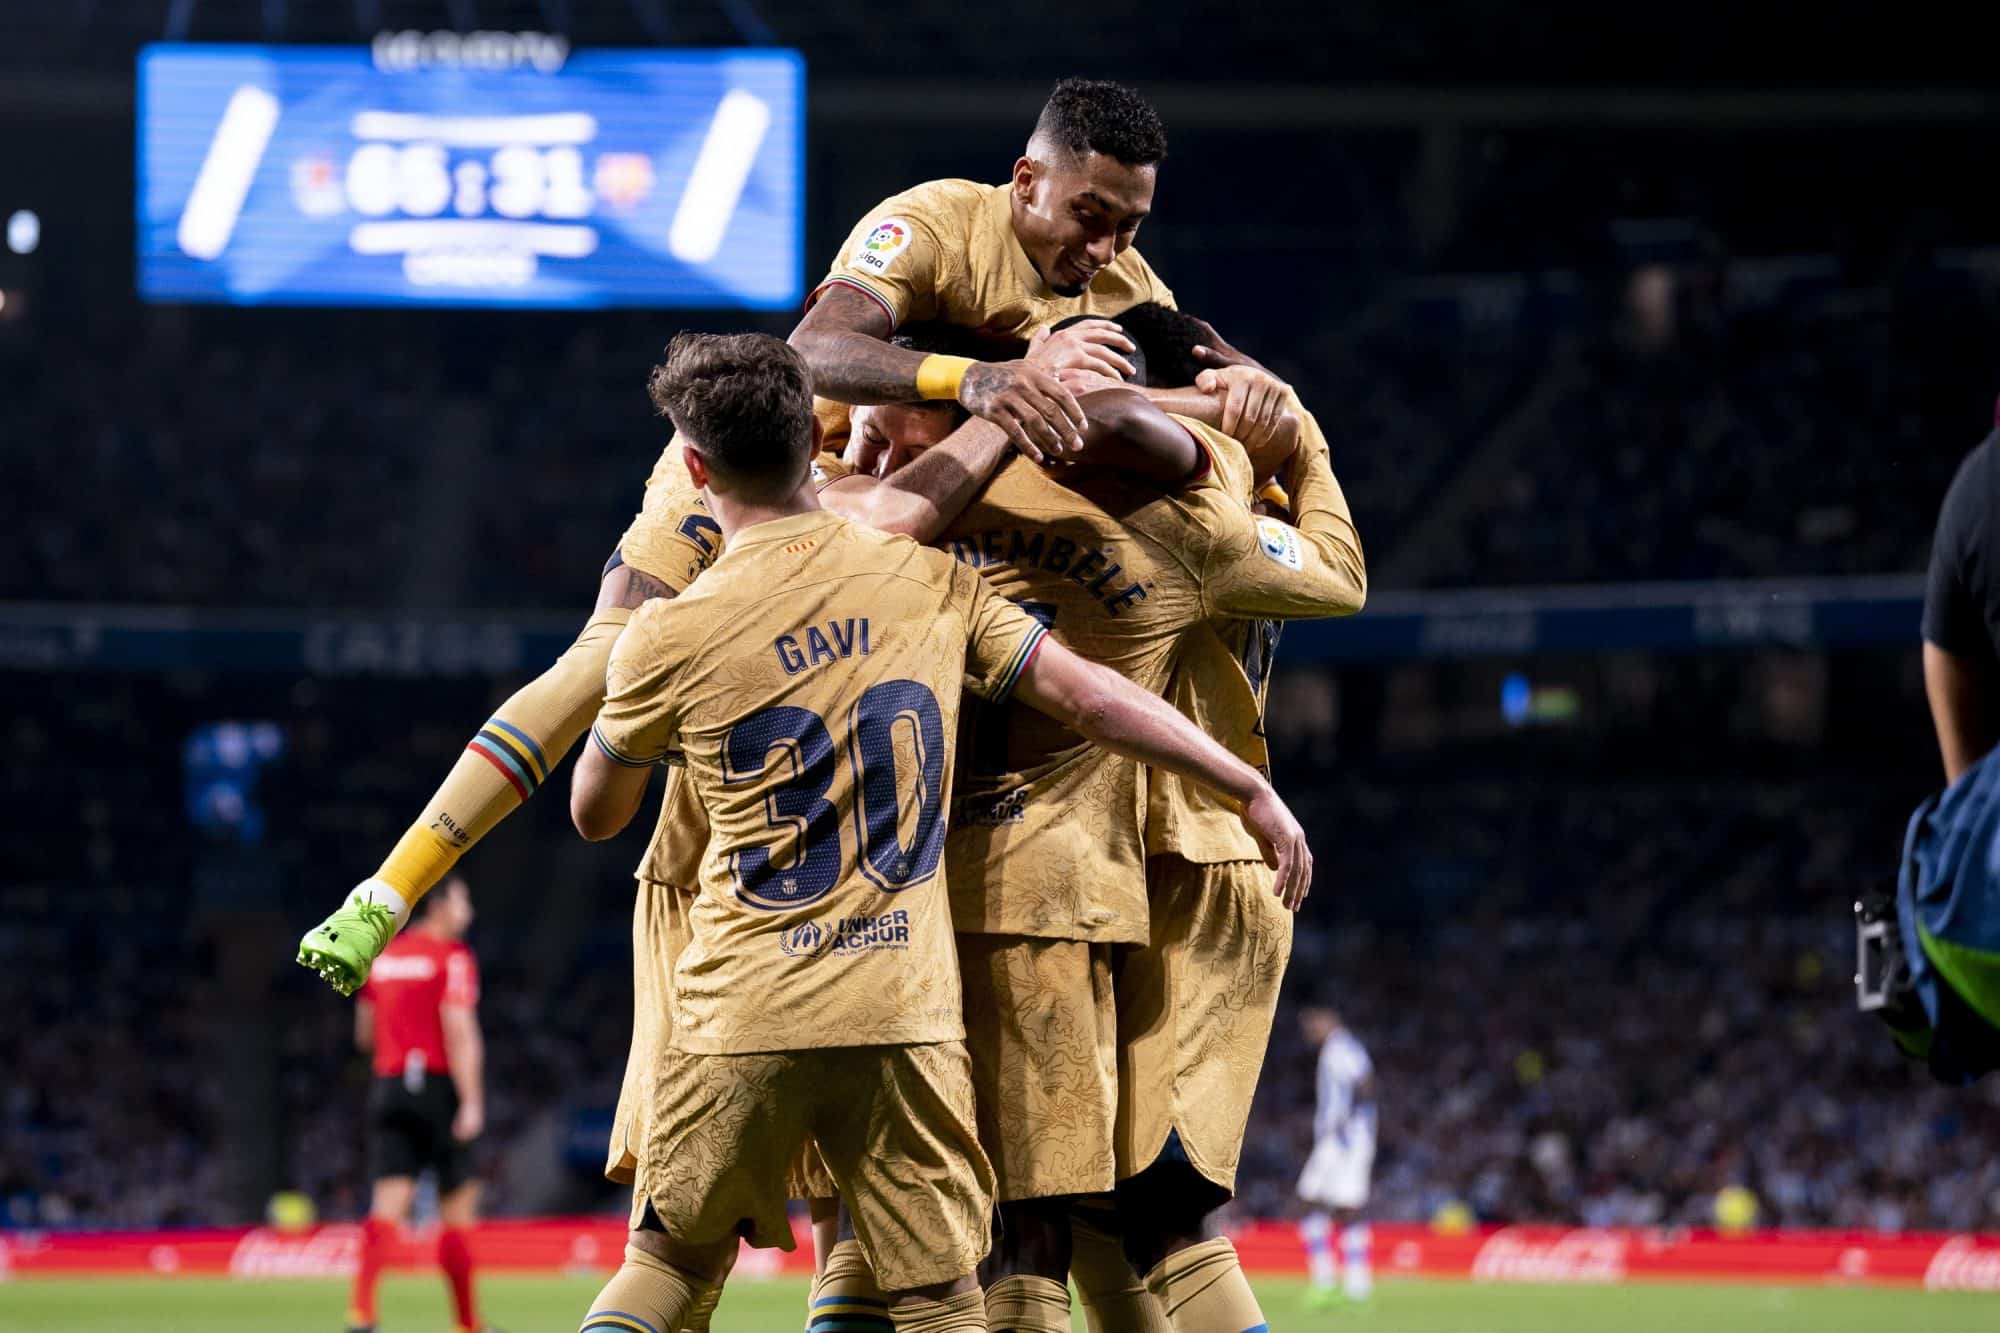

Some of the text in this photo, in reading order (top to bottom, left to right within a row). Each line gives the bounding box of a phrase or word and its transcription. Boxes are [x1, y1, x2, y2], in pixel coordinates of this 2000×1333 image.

[775, 617, 869, 676] GAVI
[720, 679, 946, 911] 30
[832, 926, 908, 950] ACNUR
